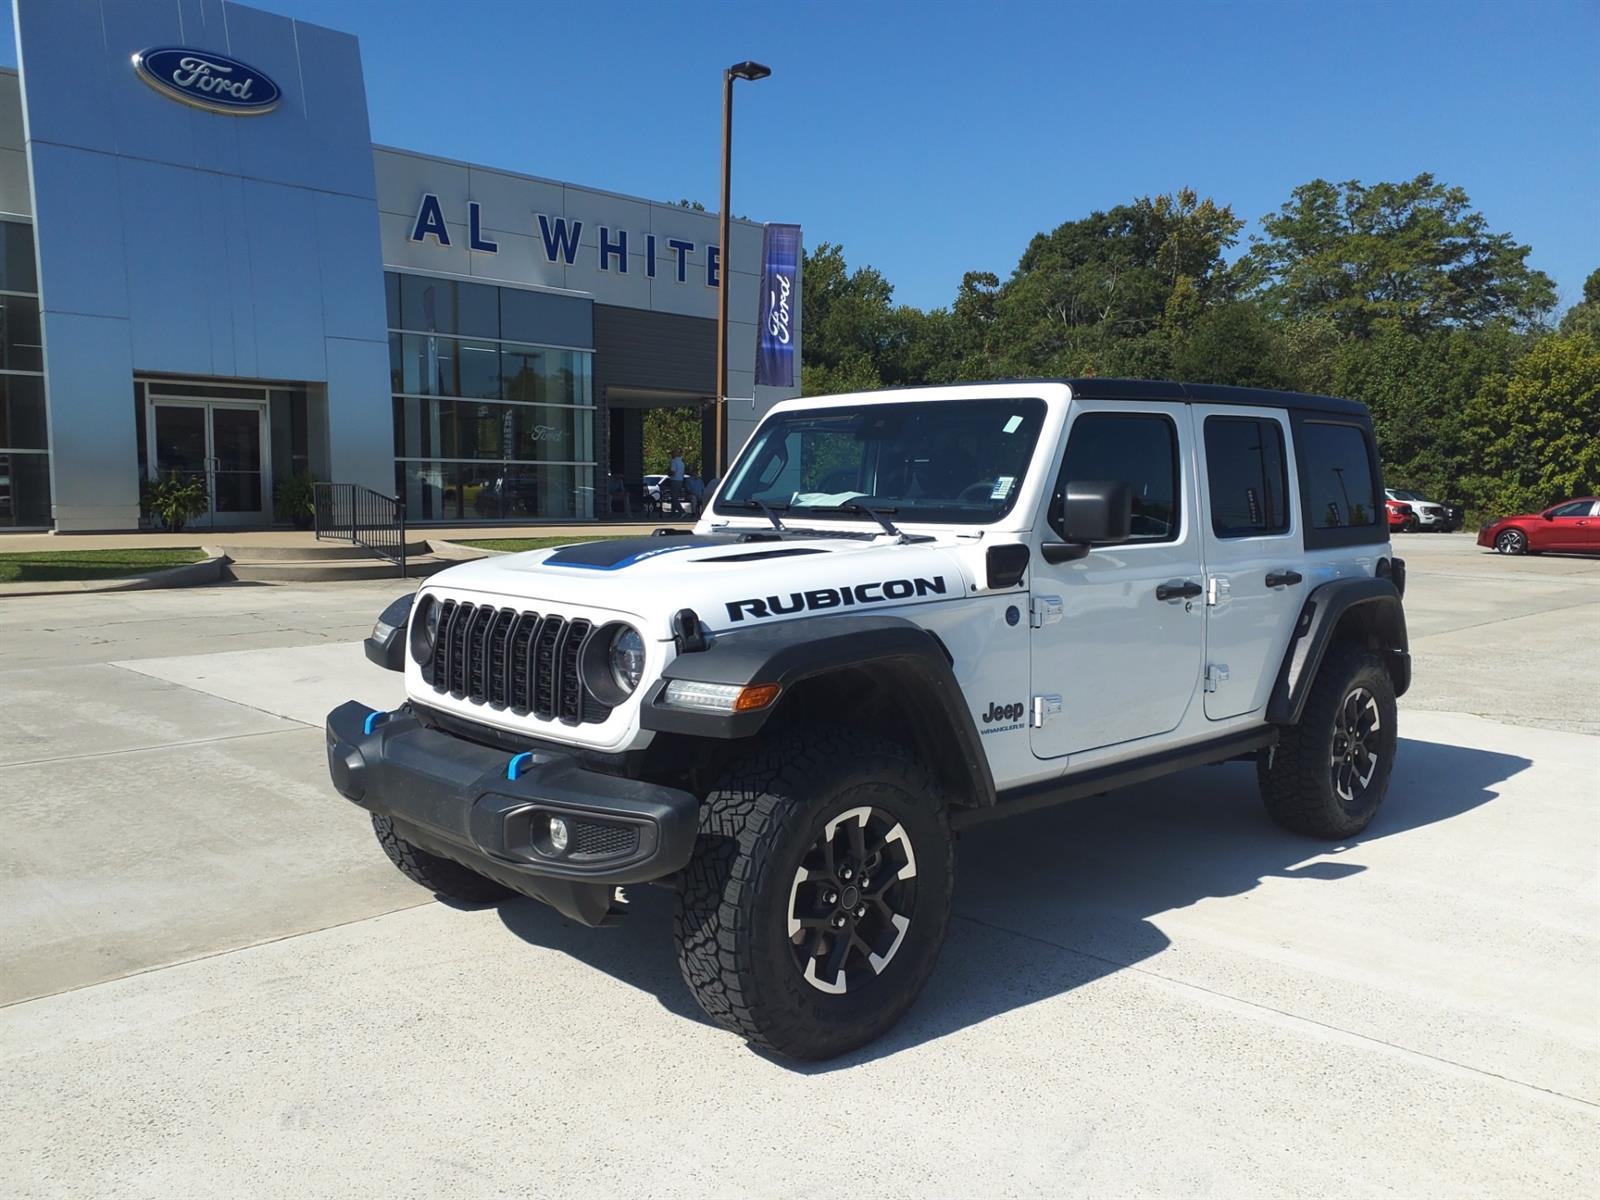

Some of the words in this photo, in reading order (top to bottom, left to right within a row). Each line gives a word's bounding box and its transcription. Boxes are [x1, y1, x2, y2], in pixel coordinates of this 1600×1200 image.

[173, 57, 253, 100] Ford
[411, 193, 498, 254] AL
[536, 213, 721, 288] WHITE
[768, 274, 790, 344] Ford
[725, 575, 947, 622] RUBICON
[982, 701, 1025, 724] Jeep
